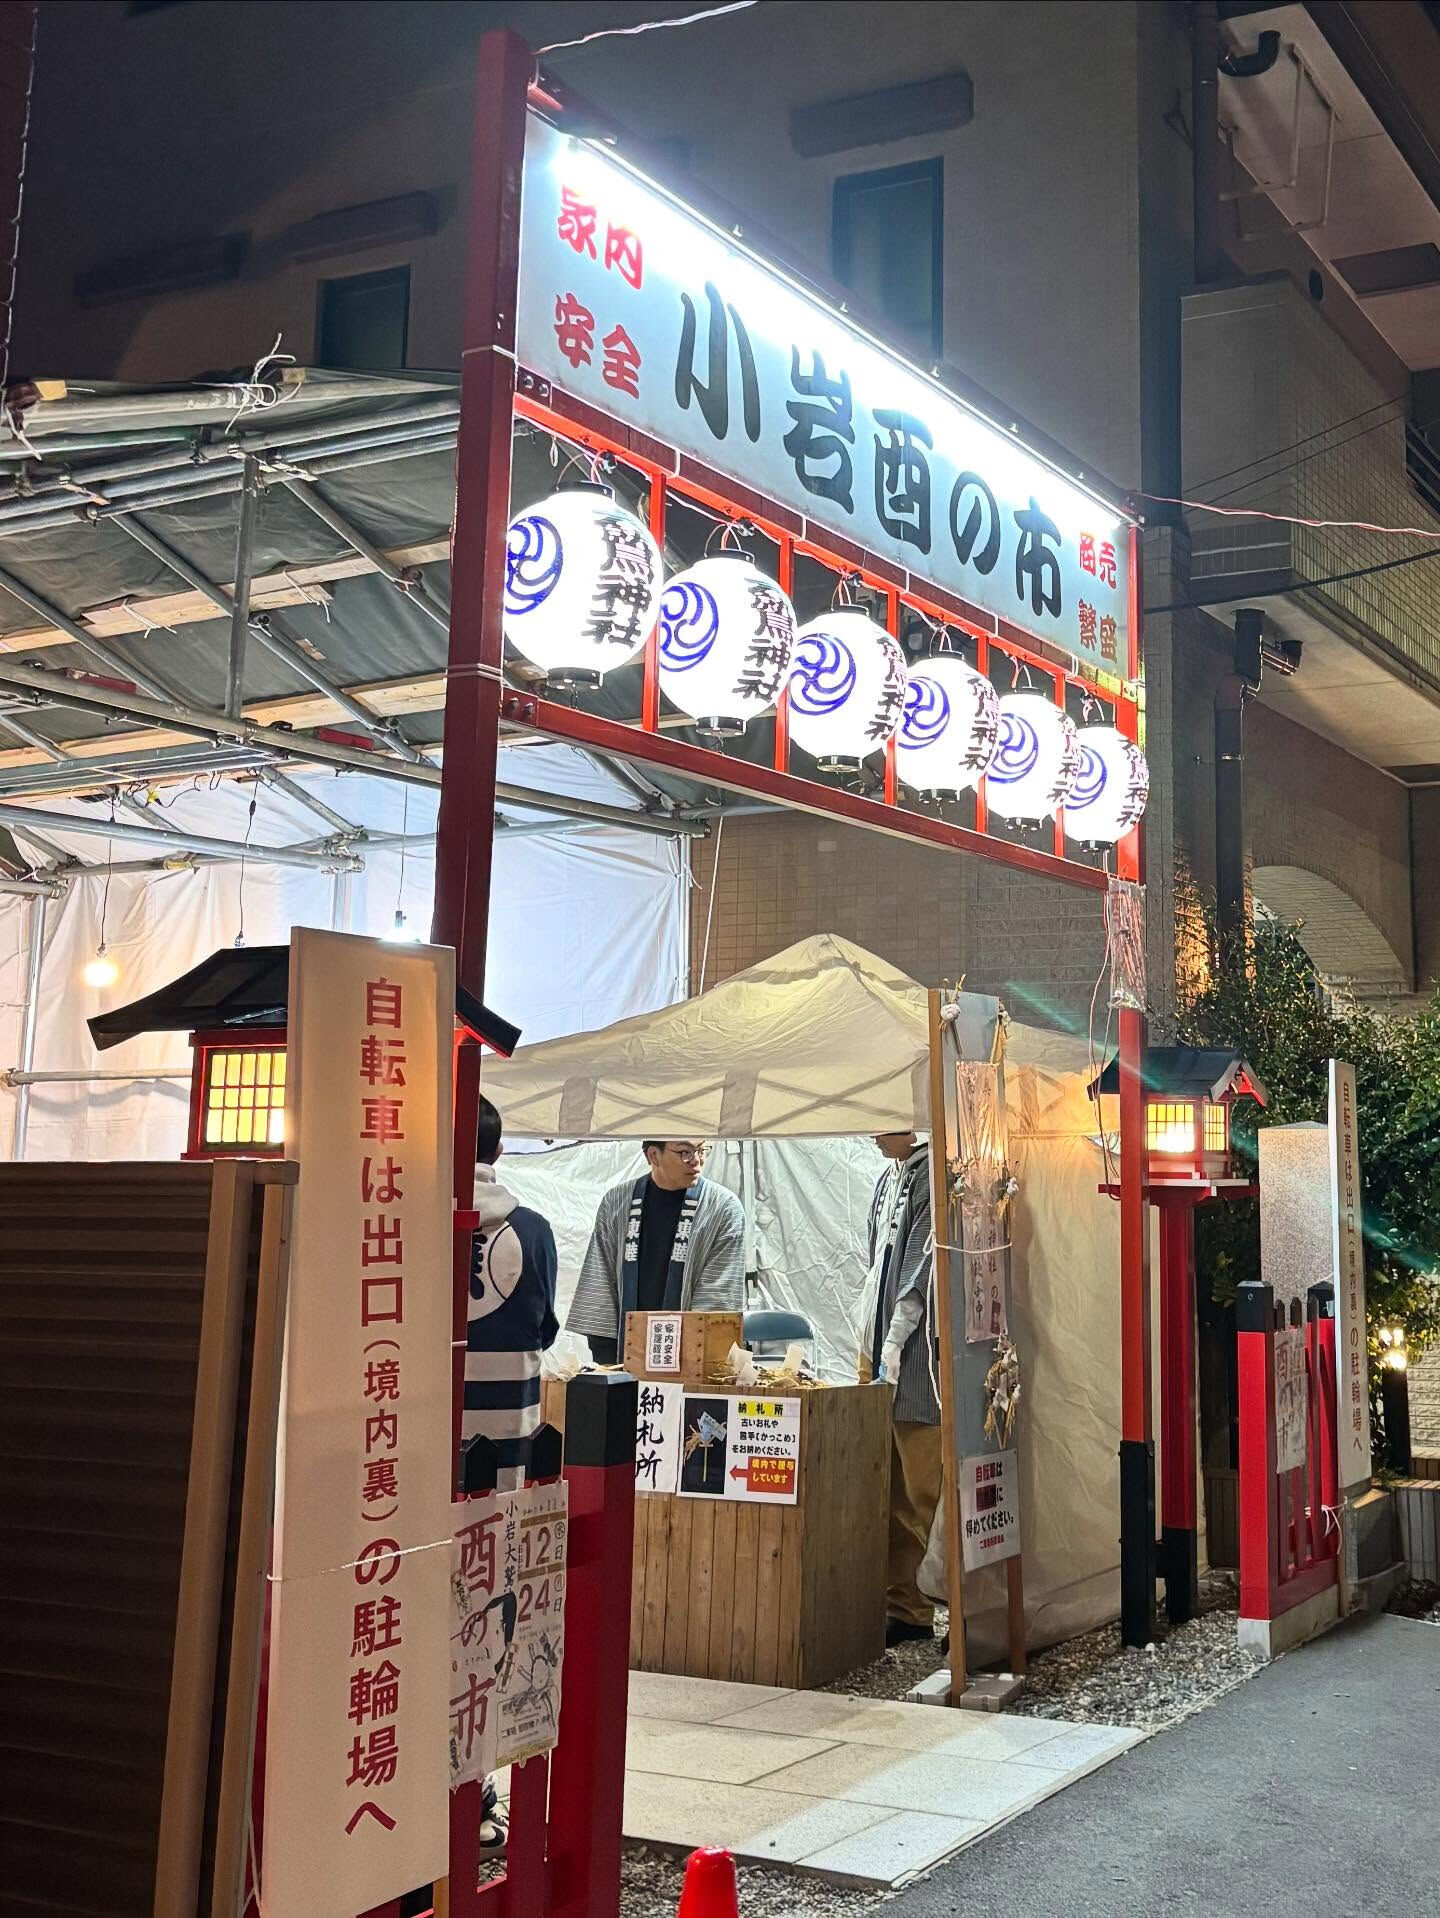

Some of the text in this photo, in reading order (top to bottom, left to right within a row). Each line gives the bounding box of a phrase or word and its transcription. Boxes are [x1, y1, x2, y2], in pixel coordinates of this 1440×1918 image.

[557, 184, 643, 289] 家内
[553, 292, 642, 400] 安全
[675, 282, 1062, 618] 小岩酉の市
[1079, 532, 1117, 590] 商売
[1078, 598, 1118, 664] 繁盛
[664, 1323, 674, 1364] 家内安全
[344, 977, 407, 1836] 自転車は出口（境内裏）の駐輪場へ
[738, 1402, 784, 1416] 納札所
[741, 1418, 779, 1429] 古いお札や
[635, 1386, 664, 1489] 納札所
[732, 1445, 791, 1456] をお納めください。
[752, 1472, 788, 1484] しています
[521, 1527, 551, 1568] 12
[517, 1578, 551, 1623] 24
[449, 1512, 503, 1760] 酉の市
